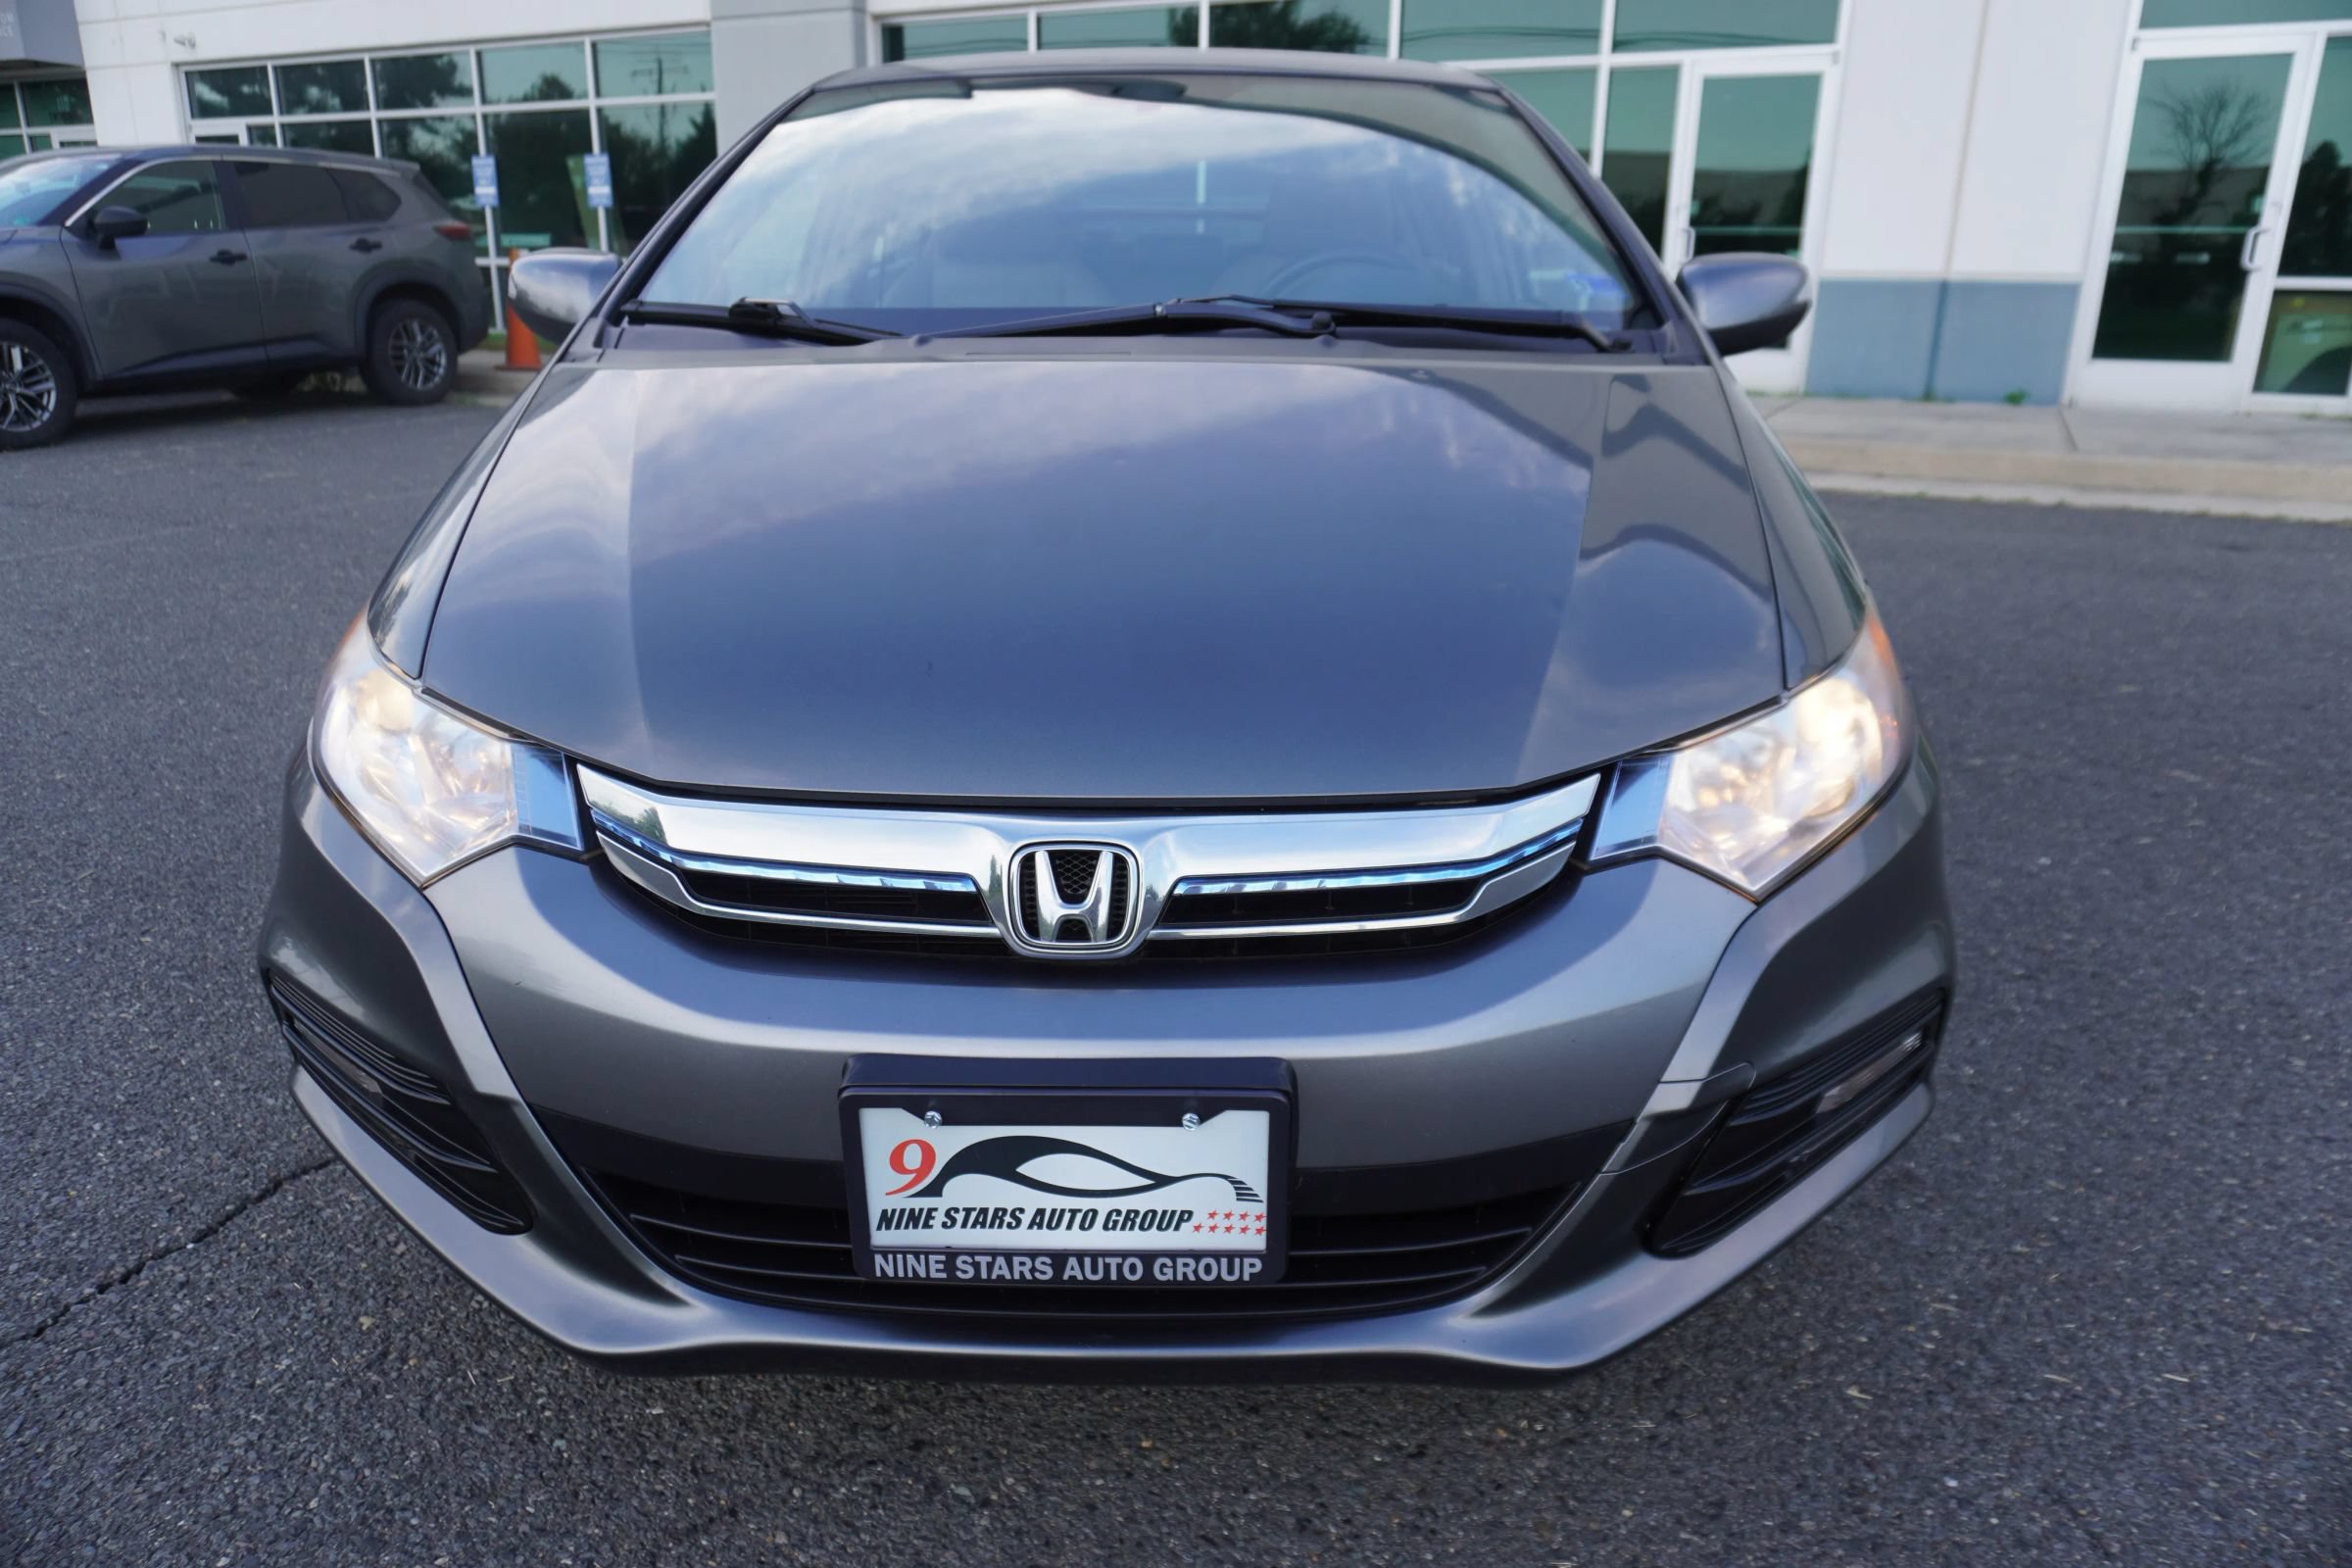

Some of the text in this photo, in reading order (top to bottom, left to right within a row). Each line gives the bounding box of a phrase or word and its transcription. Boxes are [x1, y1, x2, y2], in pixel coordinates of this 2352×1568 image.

[885, 1139, 937, 1196] 9
[876, 1206, 1194, 1232] NINE STARS AUTO GROUP
[874, 1253, 1263, 1282] NINE STARS AUTO GROUP
